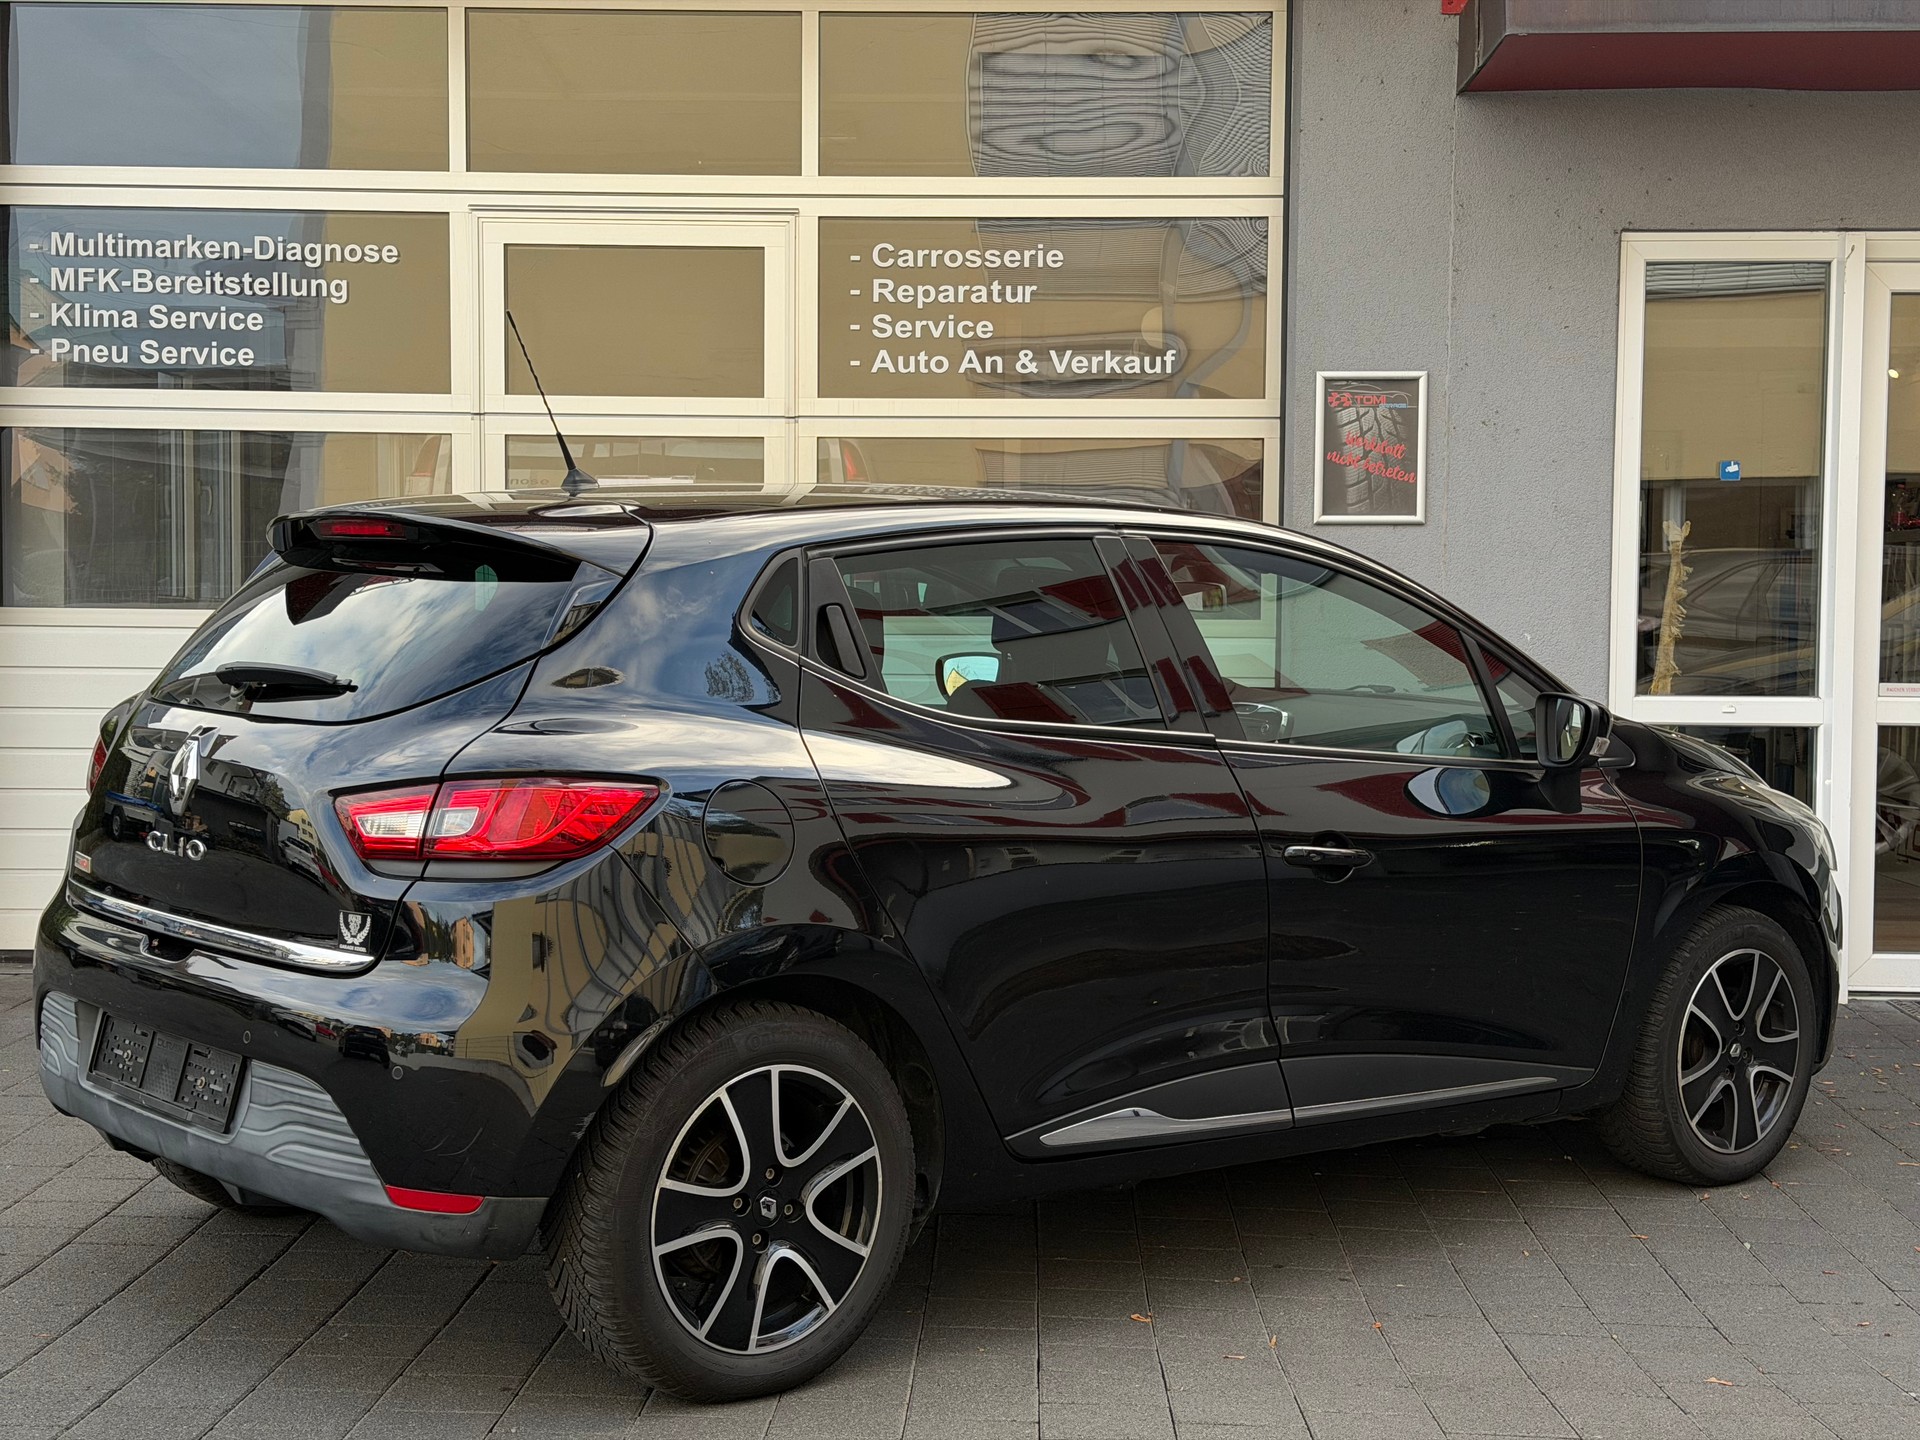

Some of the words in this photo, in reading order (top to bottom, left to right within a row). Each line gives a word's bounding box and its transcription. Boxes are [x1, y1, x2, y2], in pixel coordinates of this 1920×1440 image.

[50, 231, 399, 268] Multimarken-Diagnose
[871, 243, 1064, 268] Carrosserie
[50, 267, 349, 304] MFK-Bereitstellung
[871, 278, 1037, 309] Reparatur
[50, 303, 138, 329] Klima
[148, 305, 264, 331] Service
[871, 313, 994, 339] Service
[50, 338, 129, 365] Pneu
[139, 339, 255, 367] Service
[871, 350, 950, 374] Auto
[958, 350, 1003, 374] An
[1015, 350, 1039, 374] &
[1049, 350, 1177, 374] Verkauf
[1363, 459, 1416, 483] betreten
[146, 830, 208, 861] CLIO
